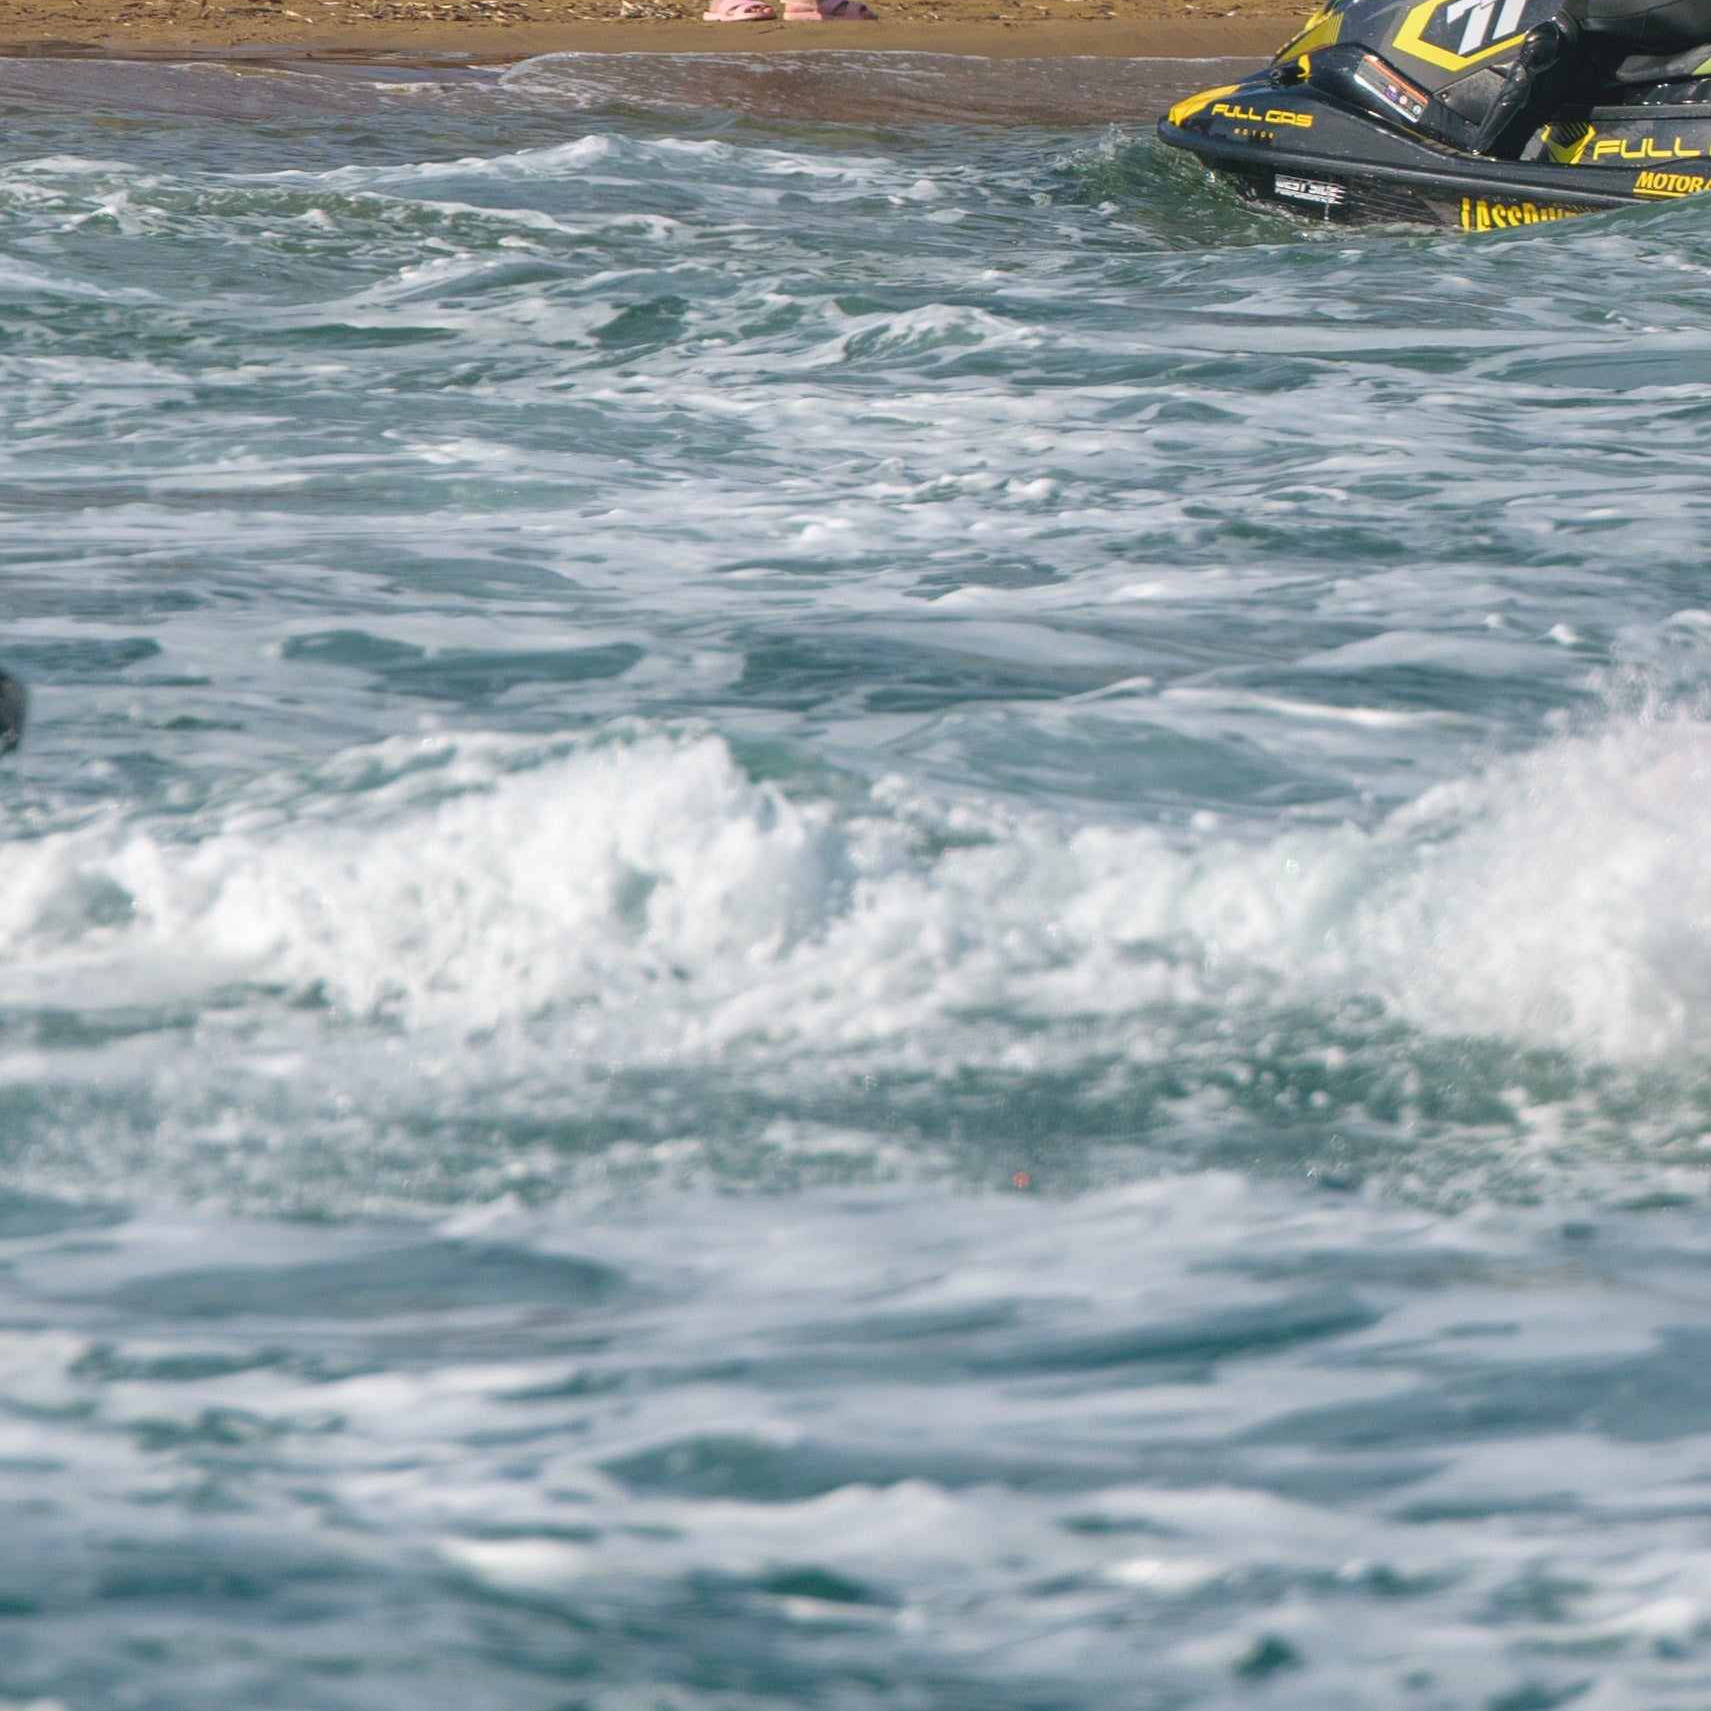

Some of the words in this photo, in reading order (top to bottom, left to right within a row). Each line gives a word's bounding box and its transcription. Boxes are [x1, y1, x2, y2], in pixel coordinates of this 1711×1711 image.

[1210, 102, 1263, 122] FULL
[1264, 109, 1314, 128] GAS
[1233, 126, 1276, 140] MOTOR
[1592, 137, 1702, 161] FULL
